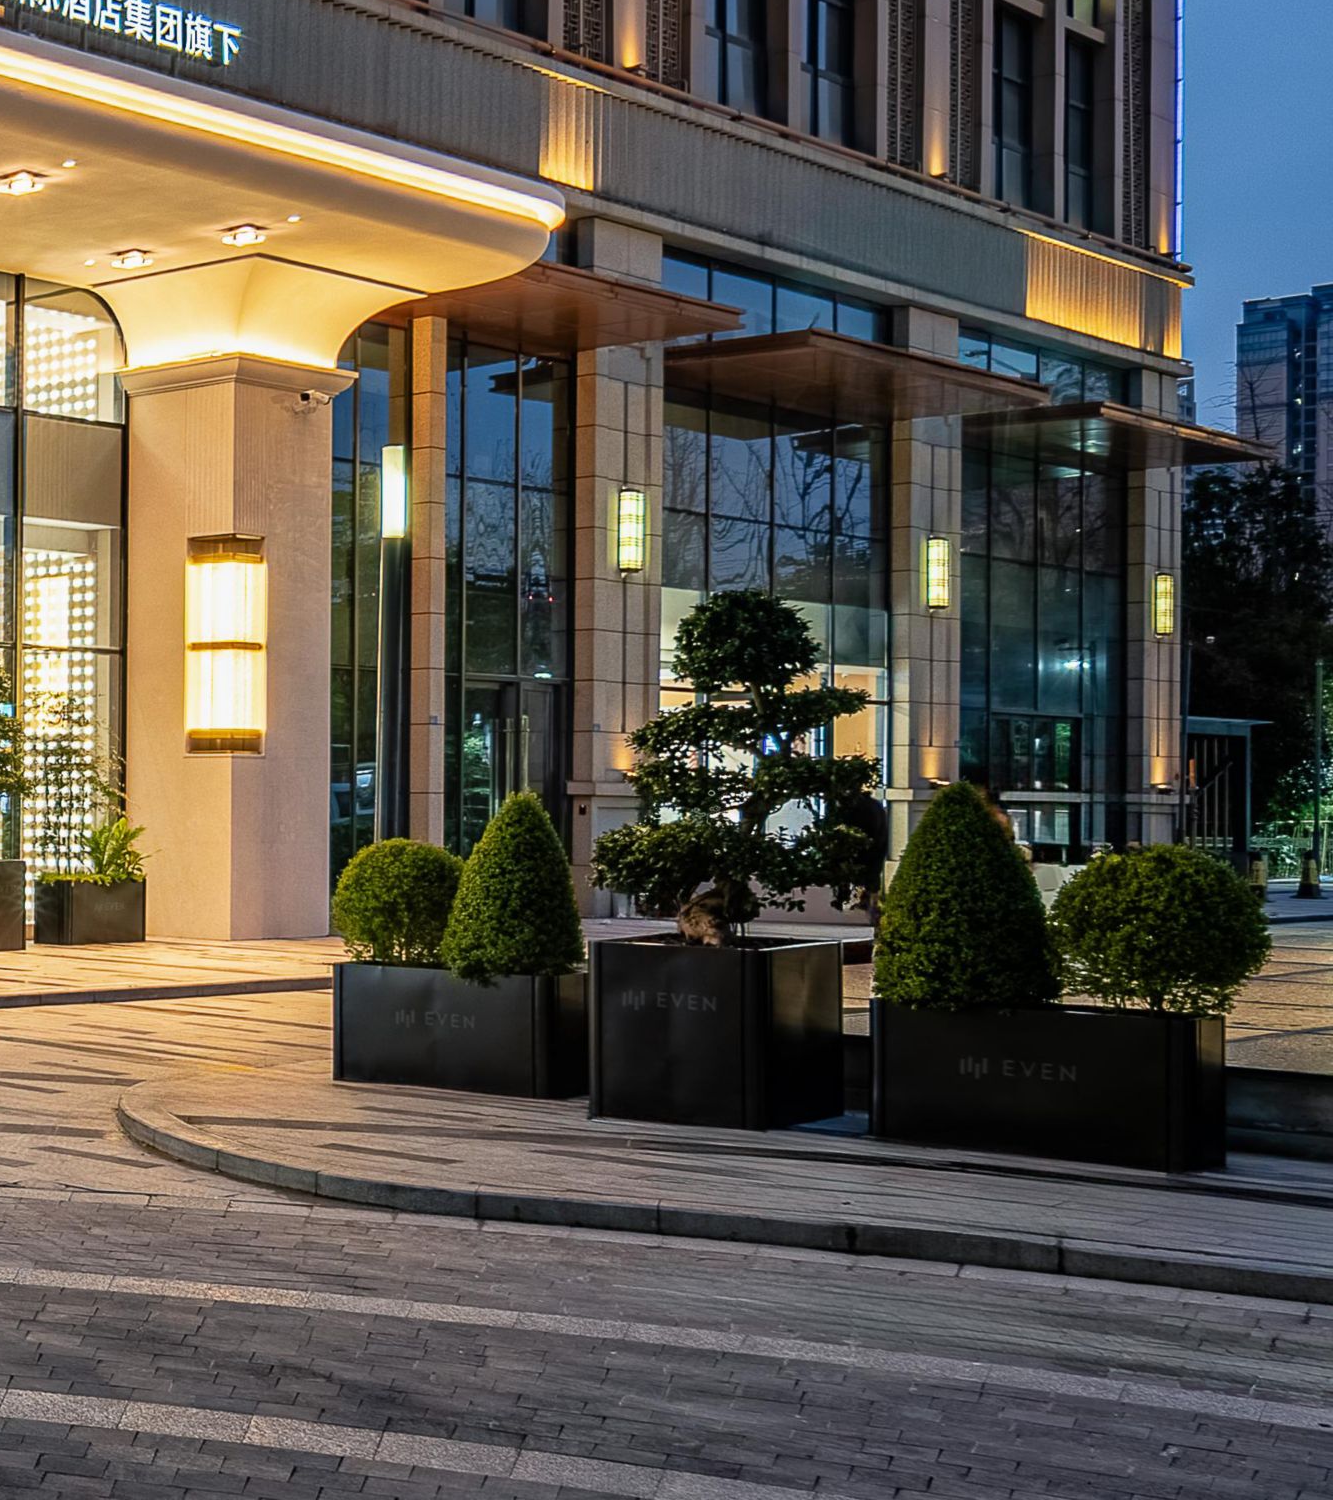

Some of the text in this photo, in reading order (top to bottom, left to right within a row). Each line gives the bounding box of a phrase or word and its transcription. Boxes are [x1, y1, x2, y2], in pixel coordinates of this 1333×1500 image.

[655, 991, 717, 1011] EVEN
[424, 1011, 476, 1029] EVEN
[1001, 1058, 1078, 1082] EVEN
